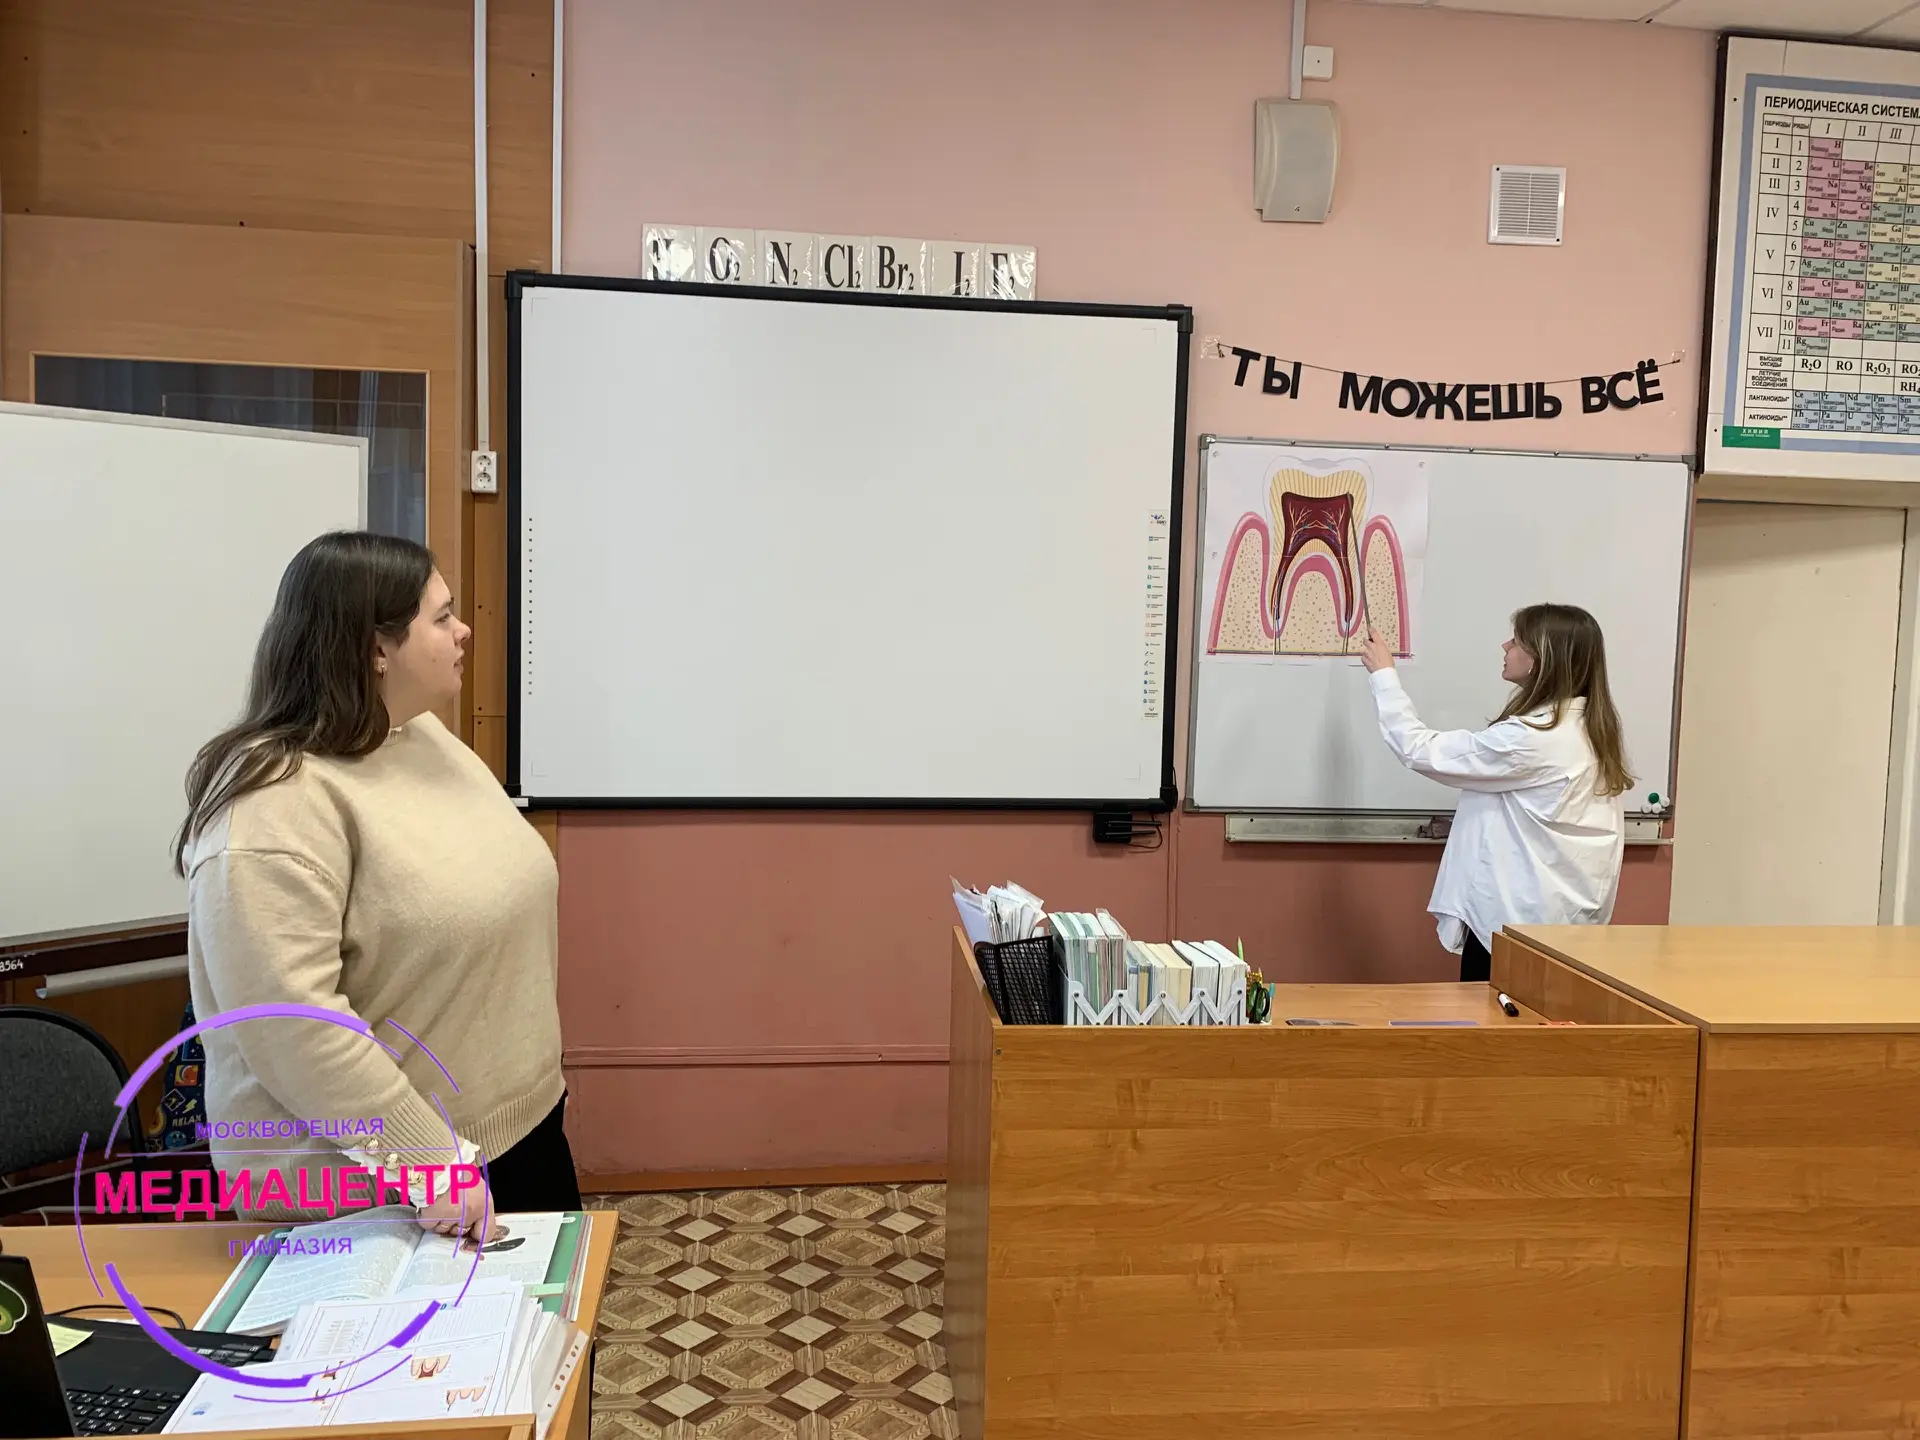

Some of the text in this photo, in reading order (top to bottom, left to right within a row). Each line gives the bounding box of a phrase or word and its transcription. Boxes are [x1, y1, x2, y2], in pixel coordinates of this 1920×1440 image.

[1764, 96, 1920, 119] ПЕРИОДИЧЕСКАЯ СИСТЕМ
[1857, 125, 1867, 136] II
[1889, 128, 1902, 139] III
[1772, 158, 1780, 168] II
[1795, 160, 1802, 171] 2
[1768, 178, 1780, 189] III
[1794, 180, 1800, 191] 3
[1827, 180, 1838, 188] Na
[1859, 183, 1872, 192] Mg
[1793, 200, 1800, 211] 4
[1860, 203, 1870, 211] Ca
[1766, 207, 1780, 218] IV
[1792, 220, 1798, 231] 5
[1837, 221, 1848, 229] Zn
[1891, 225, 1902, 233] Ga
[1791, 241, 1797, 251] 6
[1823, 240, 1834, 248] Rb
[1766, 249, 1775, 259] V
[1790, 260, 1796, 271] 7
[1801, 259, 1812, 268] Ag
[1787, 280, 1793, 291] 8
[1762, 288, 1774, 298] VI
[1786, 300, 1792, 310] 9
[1832, 300, 1843, 310] Hg
[1784, 320, 1794, 330] 10
[1757, 326, 1773, 338] VII
[1796, 337, 1807, 346] Rg
[1836, 361, 1853, 371] RO
[1231, 346, 1664, 421] ТЫ МОЖЕШЬ ВСЁ
[1794, 390, 1804, 398] Ce
[1847, 393, 1858, 401] Nd
